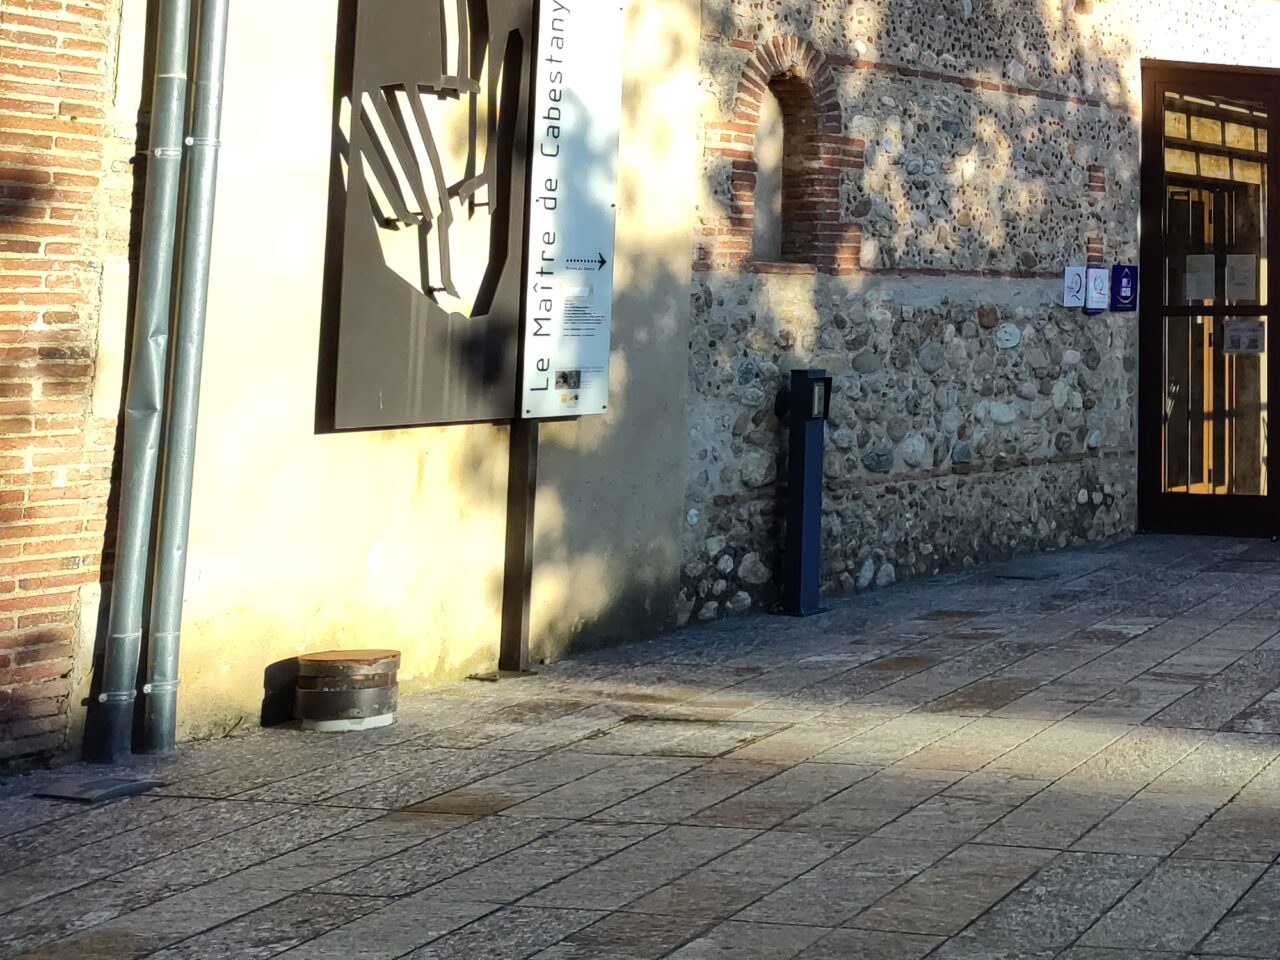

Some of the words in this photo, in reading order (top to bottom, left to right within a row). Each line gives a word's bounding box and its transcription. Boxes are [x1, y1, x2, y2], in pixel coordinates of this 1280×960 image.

[540, 0, 571, 157] Cabestany
[539, 178, 558, 211] de
[533, 231, 556, 337] Maître
[530, 357, 550, 391] Le
